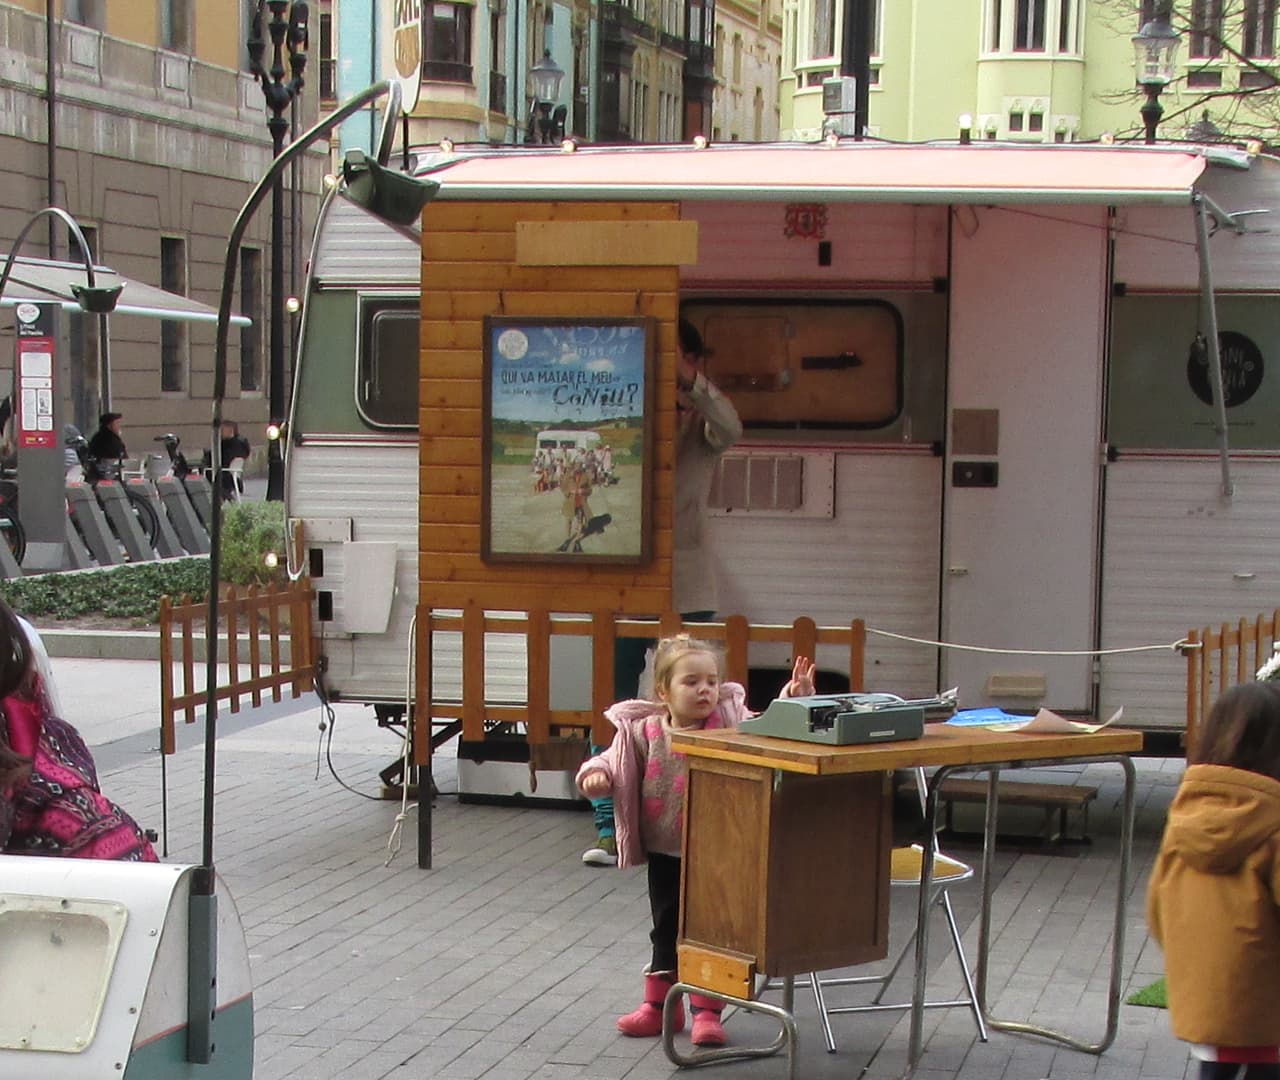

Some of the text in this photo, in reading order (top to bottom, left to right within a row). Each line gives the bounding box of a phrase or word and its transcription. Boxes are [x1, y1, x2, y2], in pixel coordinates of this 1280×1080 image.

[501, 371, 517, 384] QUI
[520, 371, 535, 384] VA
[538, 371, 575, 384] MATAR
[577, 371, 588, 384] EL
